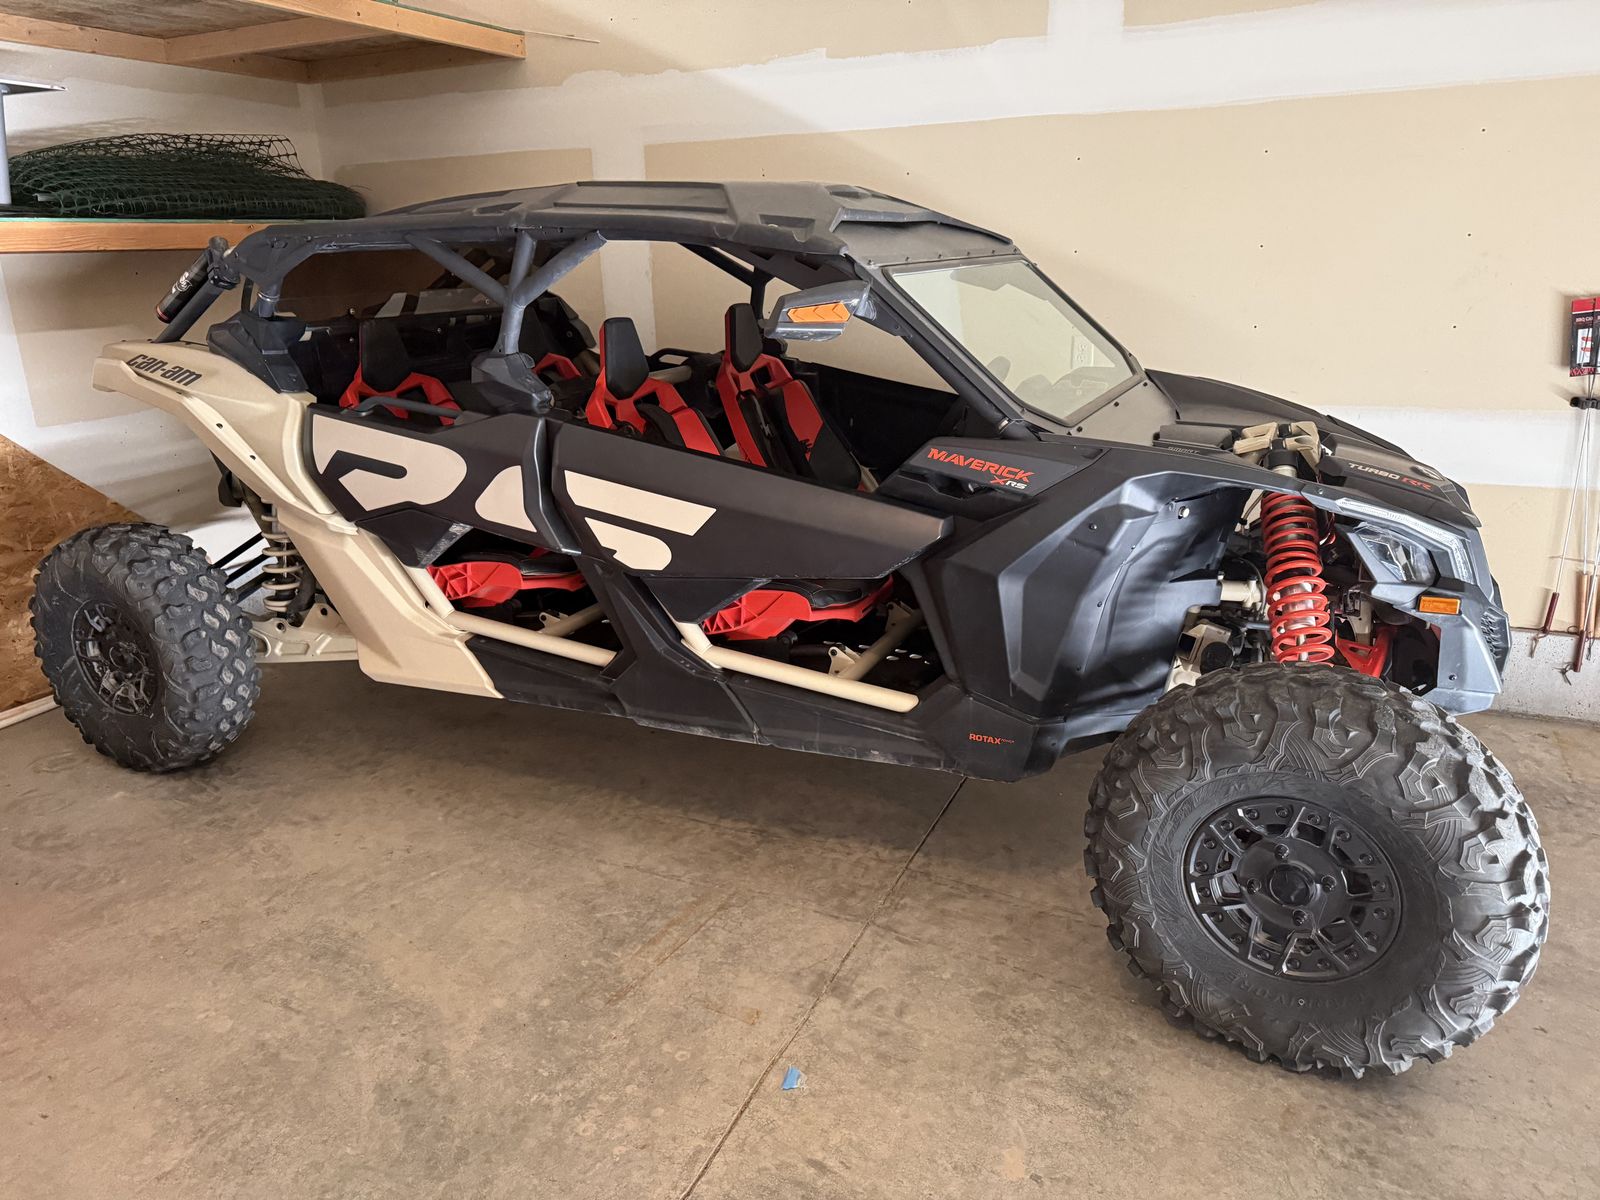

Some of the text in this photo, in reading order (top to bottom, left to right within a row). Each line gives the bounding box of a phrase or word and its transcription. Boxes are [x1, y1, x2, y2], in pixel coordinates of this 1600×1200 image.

[126, 353, 202, 386] can-am
[927, 447, 1035, 483] MAVERICK
[1348, 462, 1401, 480] TURBO
[968, 733, 1001, 745] ROTAX
